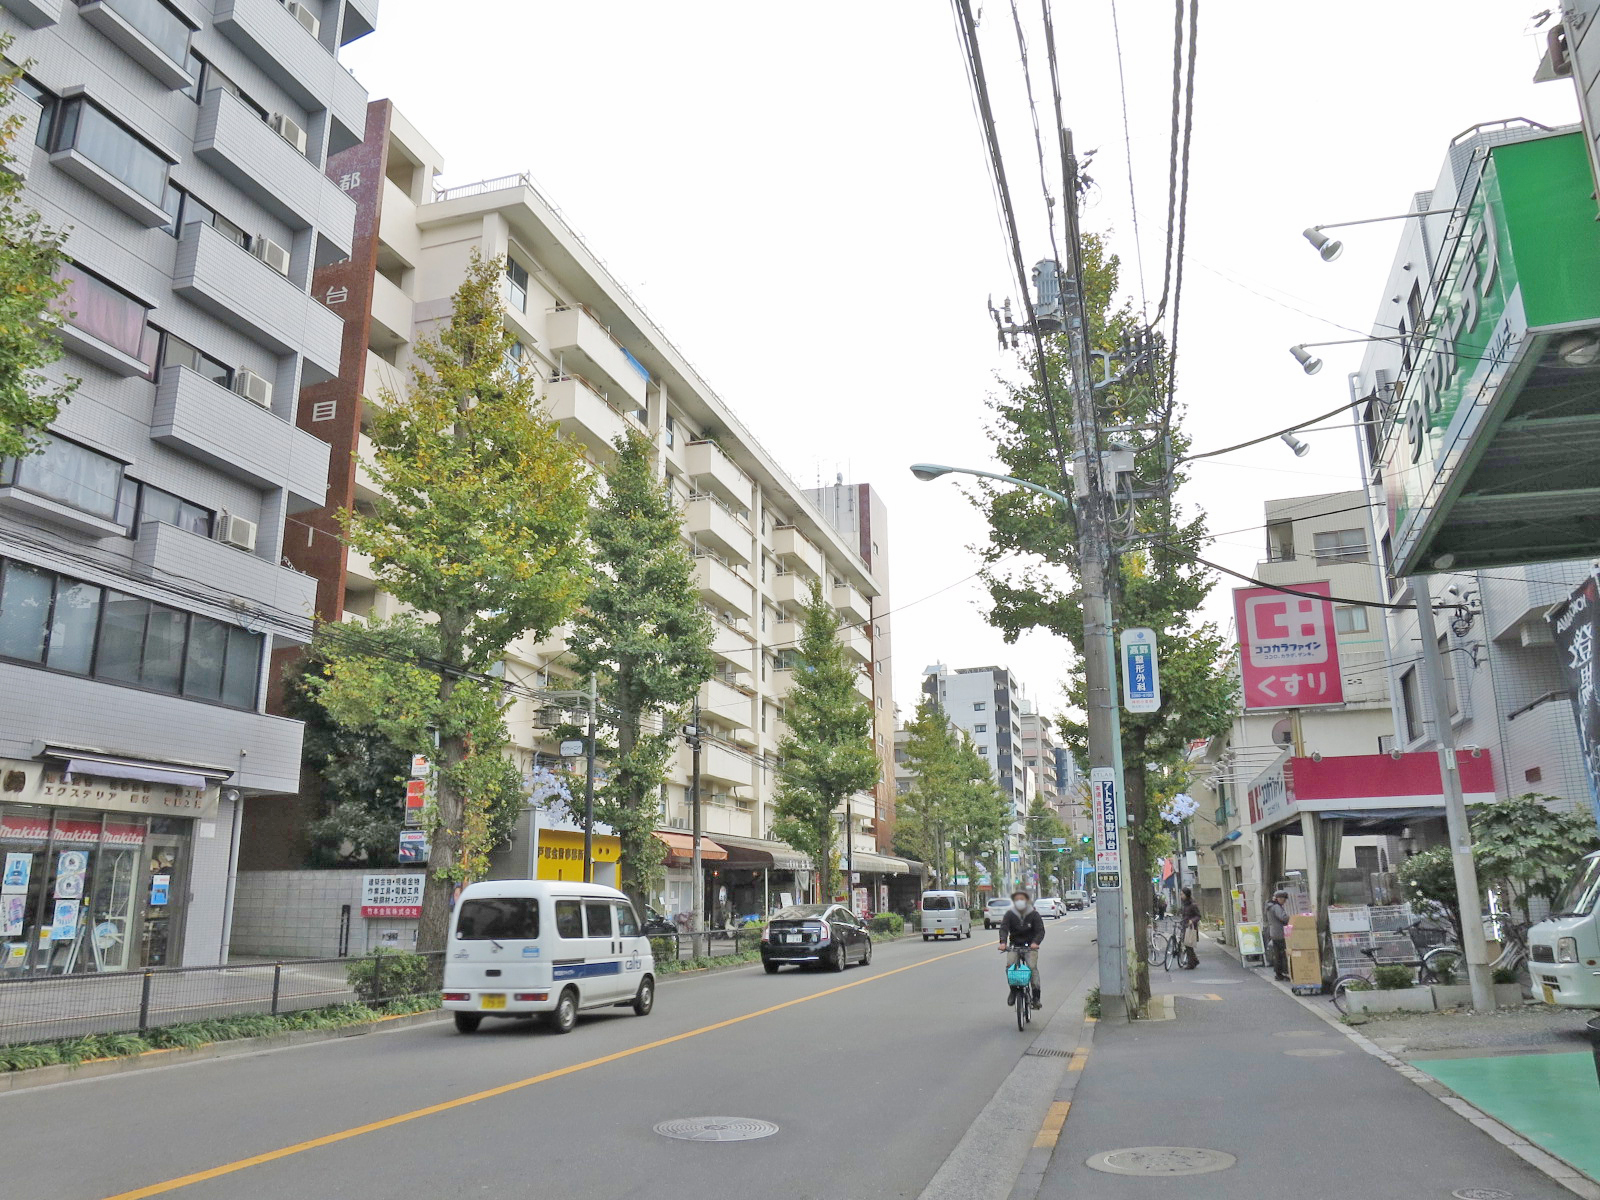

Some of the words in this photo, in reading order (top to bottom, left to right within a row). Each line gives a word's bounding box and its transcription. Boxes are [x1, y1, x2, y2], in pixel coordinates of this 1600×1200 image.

[1255, 642, 1321, 655] ココカラファイン
[1135, 655, 1147, 692] 整形外科
[1258, 672, 1327, 698] くすり
[1104, 782, 1116, 850] アトラス中野南台
[0, 825, 48, 840] makita
[53, 829, 99, 843] makita
[103, 831, 144, 845] makita
